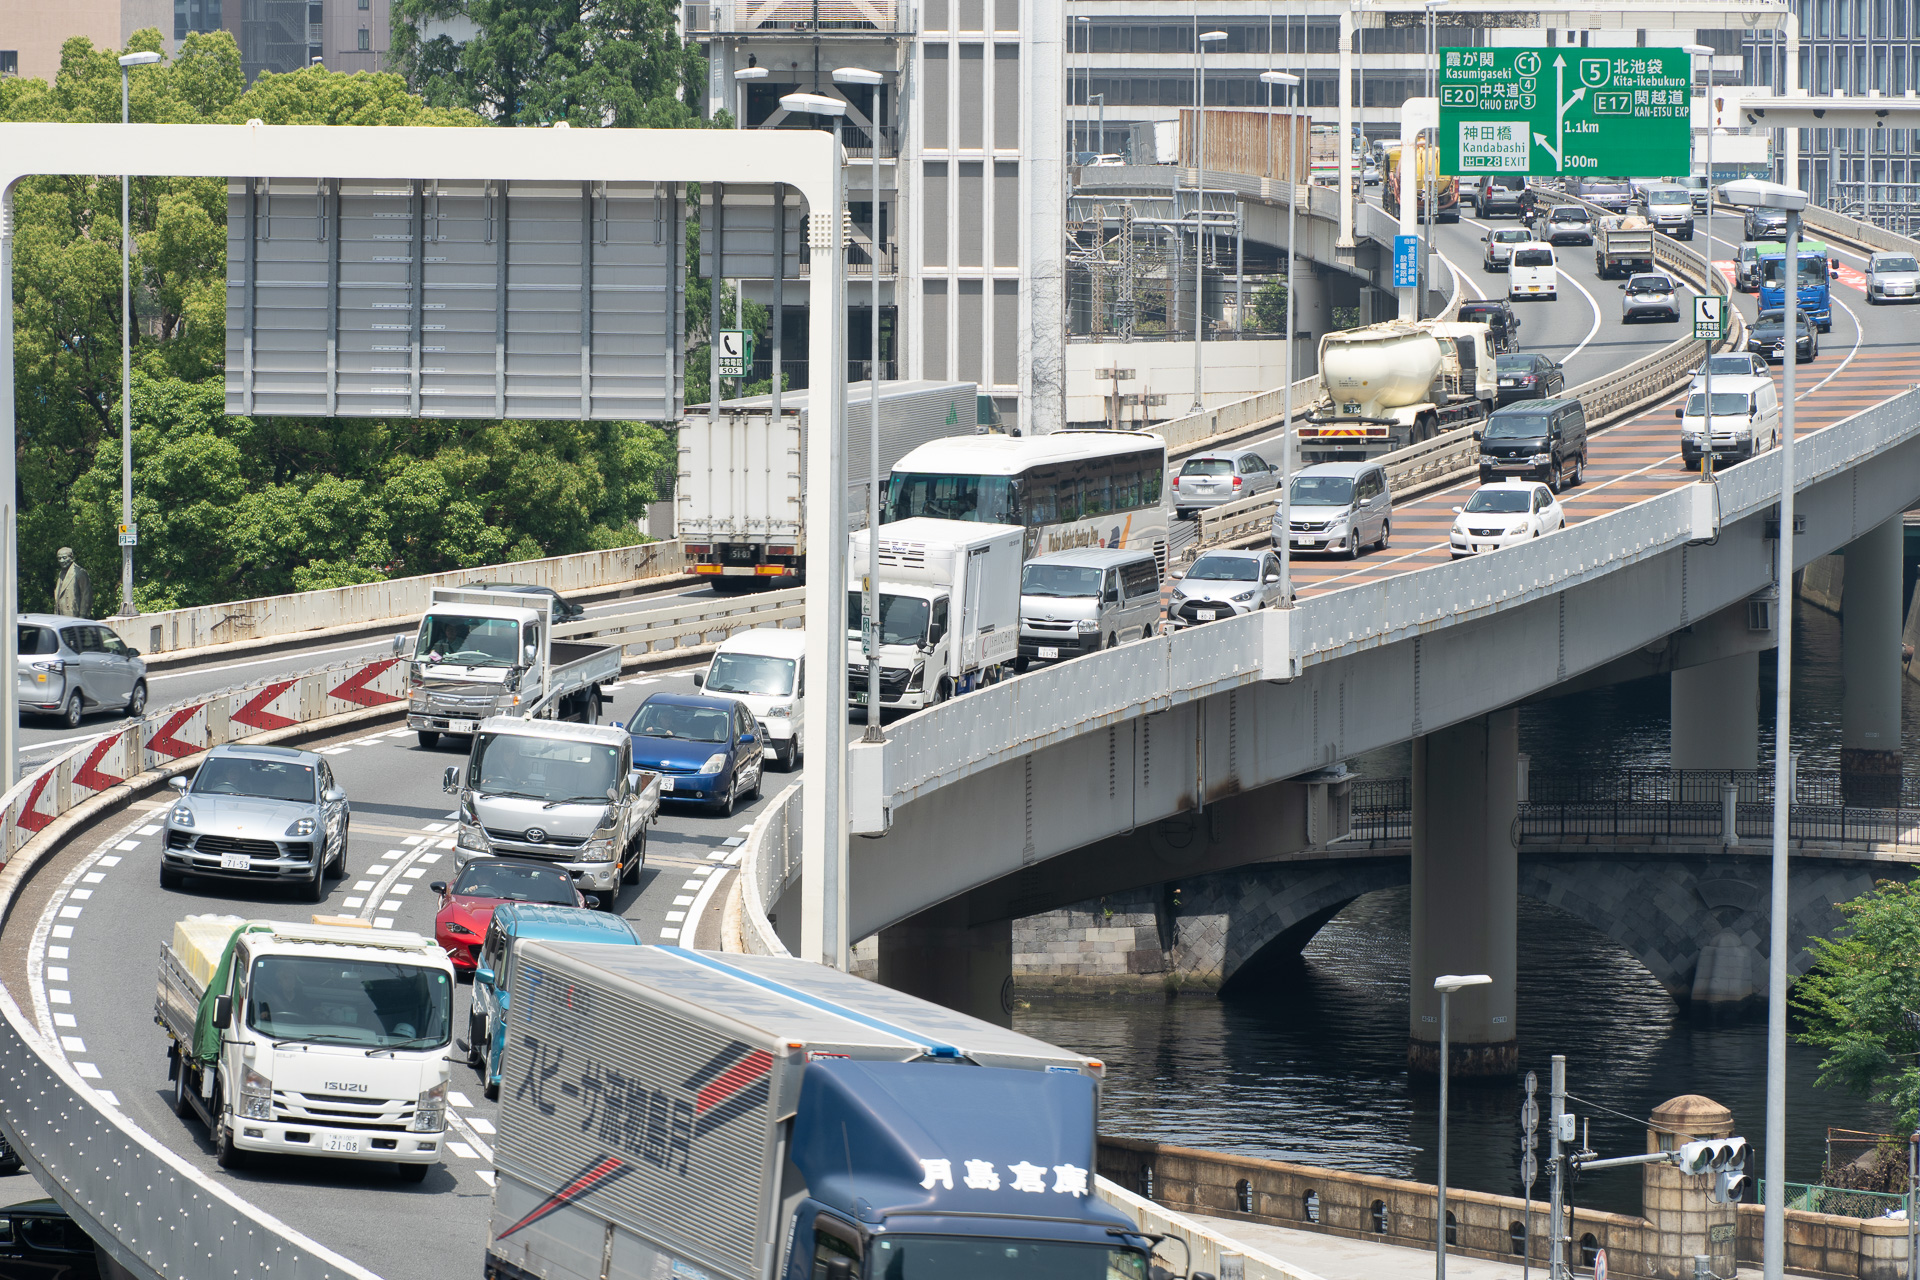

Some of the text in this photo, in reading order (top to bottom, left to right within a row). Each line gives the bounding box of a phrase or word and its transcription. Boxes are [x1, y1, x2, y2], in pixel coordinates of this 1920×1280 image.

[1446, 52, 1494, 67] 霞が関
[1519, 56, 1536, 72] C1
[1590, 64, 1600, 81] 5
[1614, 59, 1662, 74] 北池袋
[1446, 68, 1511, 81] Kasumigaseki
[1613, 75, 1685, 86] Kita-ikebukuro
[1480, 83, 1518, 98] 中央道
[1524, 80, 1530, 89] 4
[1444, 90, 1474, 102] E20
[1524, 97, 1530, 106] 3
[1635, 90, 1684, 105] 関越道
[1480, 100, 1518, 110] CHUO EXP
[1598, 97, 1628, 110] E17
[1635, 107, 1689, 117] KAN-ETSU EXP
[1564, 121, 1599, 133] 1.1km
[1464, 126, 1512, 141] 神田橋
[1463, 142, 1525, 153] Kandabashi
[1505, 157, 1526, 167] EXIT
[1564, 156, 1597, 168] 500m
[324, 1081, 368, 1093] ISUZU
[330, 1140, 357, 1151] 21-08
[919, 1158, 1089, 1198] 月島倉庫
